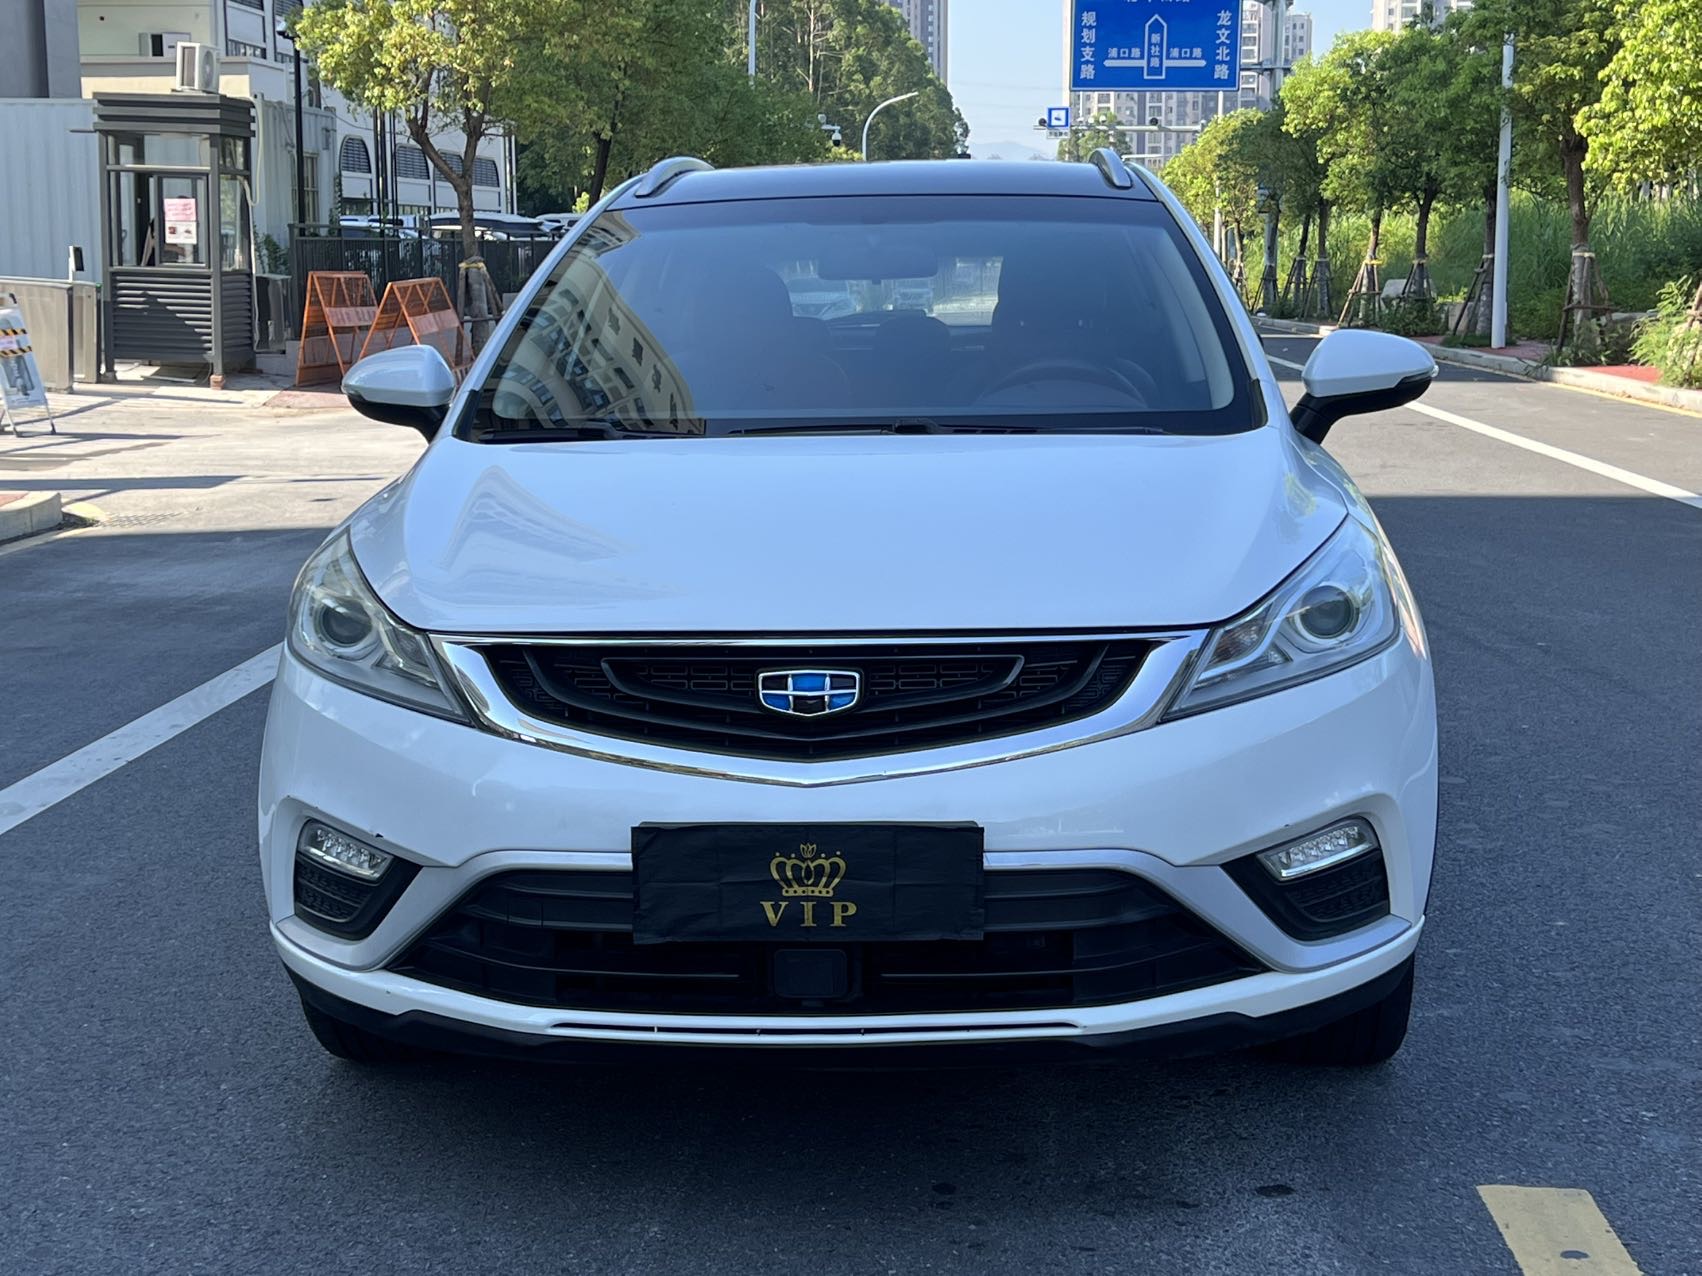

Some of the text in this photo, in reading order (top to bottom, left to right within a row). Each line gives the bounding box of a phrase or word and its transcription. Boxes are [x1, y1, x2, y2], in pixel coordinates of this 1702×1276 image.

[1080, 11, 1097, 80] 规划支路
[1214, 10, 1232, 80] 龙文北路
[759, 901, 858, 928] VIP
